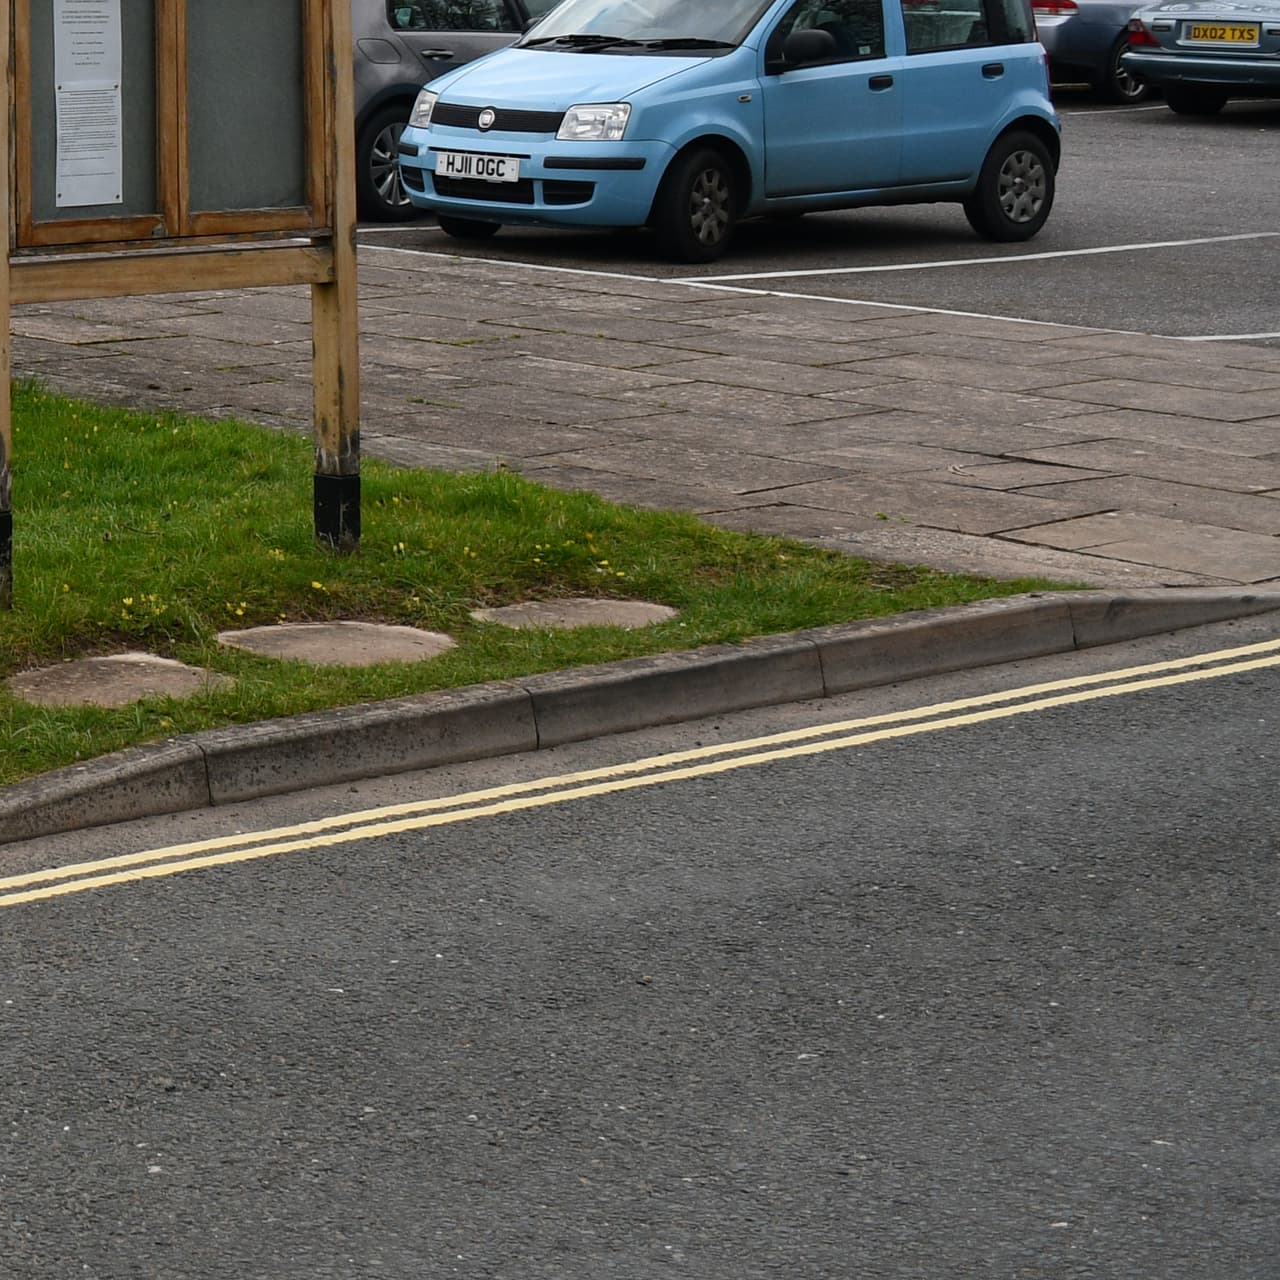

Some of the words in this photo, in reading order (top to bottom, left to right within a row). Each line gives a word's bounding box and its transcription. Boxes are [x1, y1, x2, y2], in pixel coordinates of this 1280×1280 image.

[1192, 26, 1226, 40] DX02
[1230, 28, 1255, 41] TXS
[446, 154, 472, 175] HJ11
[476, 159, 506, 177] OGC
